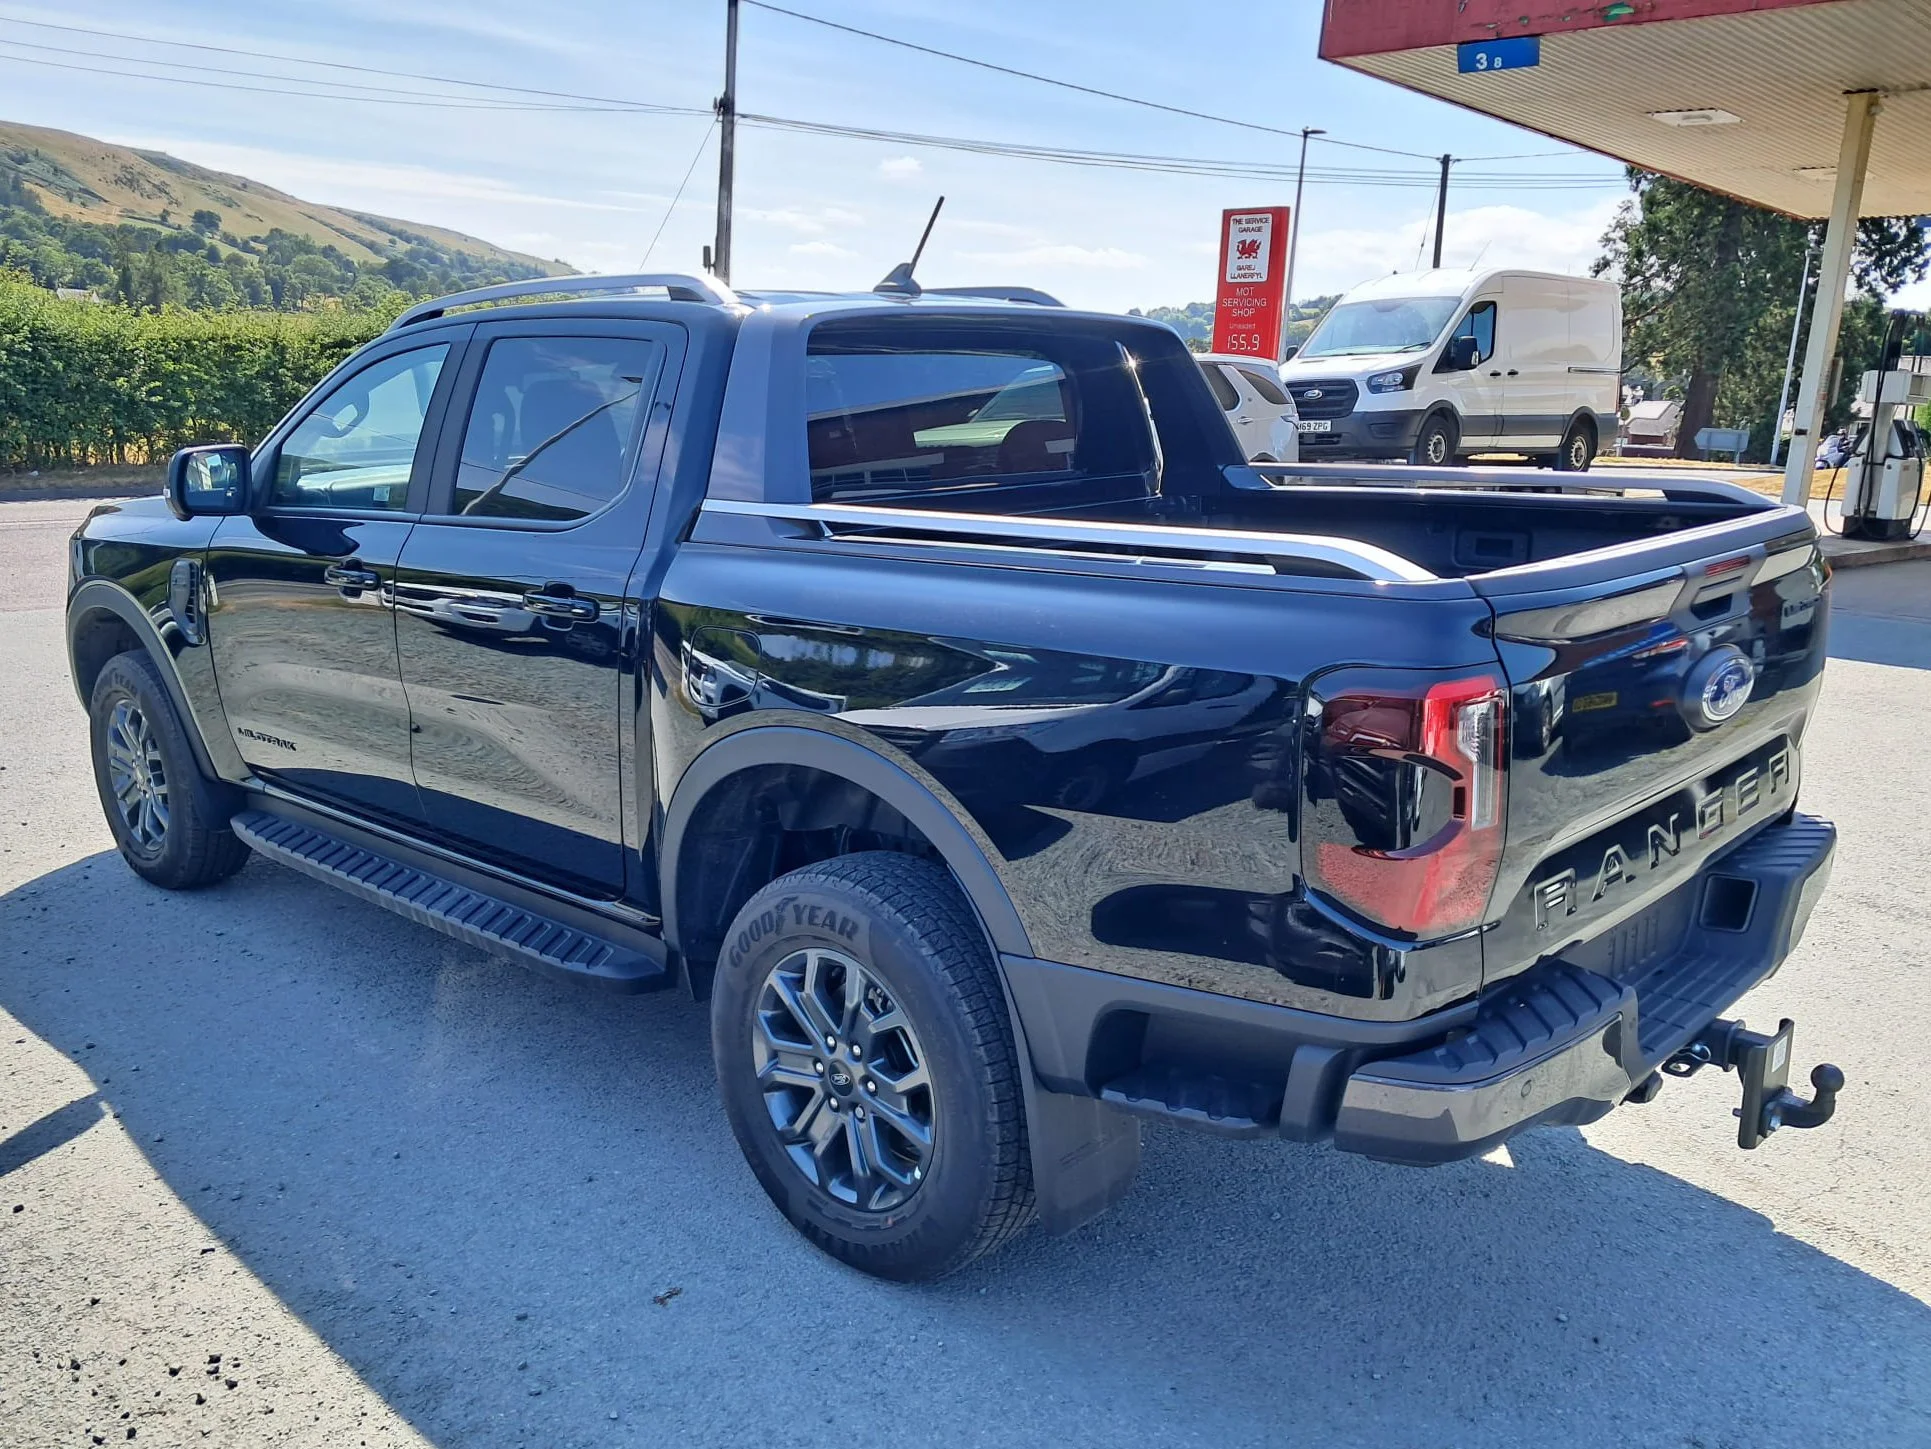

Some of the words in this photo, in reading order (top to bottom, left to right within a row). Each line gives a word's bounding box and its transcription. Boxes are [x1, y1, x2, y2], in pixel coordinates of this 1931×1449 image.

[1475, 52, 1488, 69] 3
[1494, 56, 1502, 68] 8
[1244, 217, 1270, 225] SERVICE
[1236, 286, 1254, 296] MOT
[1222, 297, 1267, 307] SERVICING
[1232, 308, 1255, 317] SHOP
[1227, 333, 1260, 351] 155.9
[1313, 422, 1328, 431] ZPG
[1534, 748, 1789, 931] RANGER
